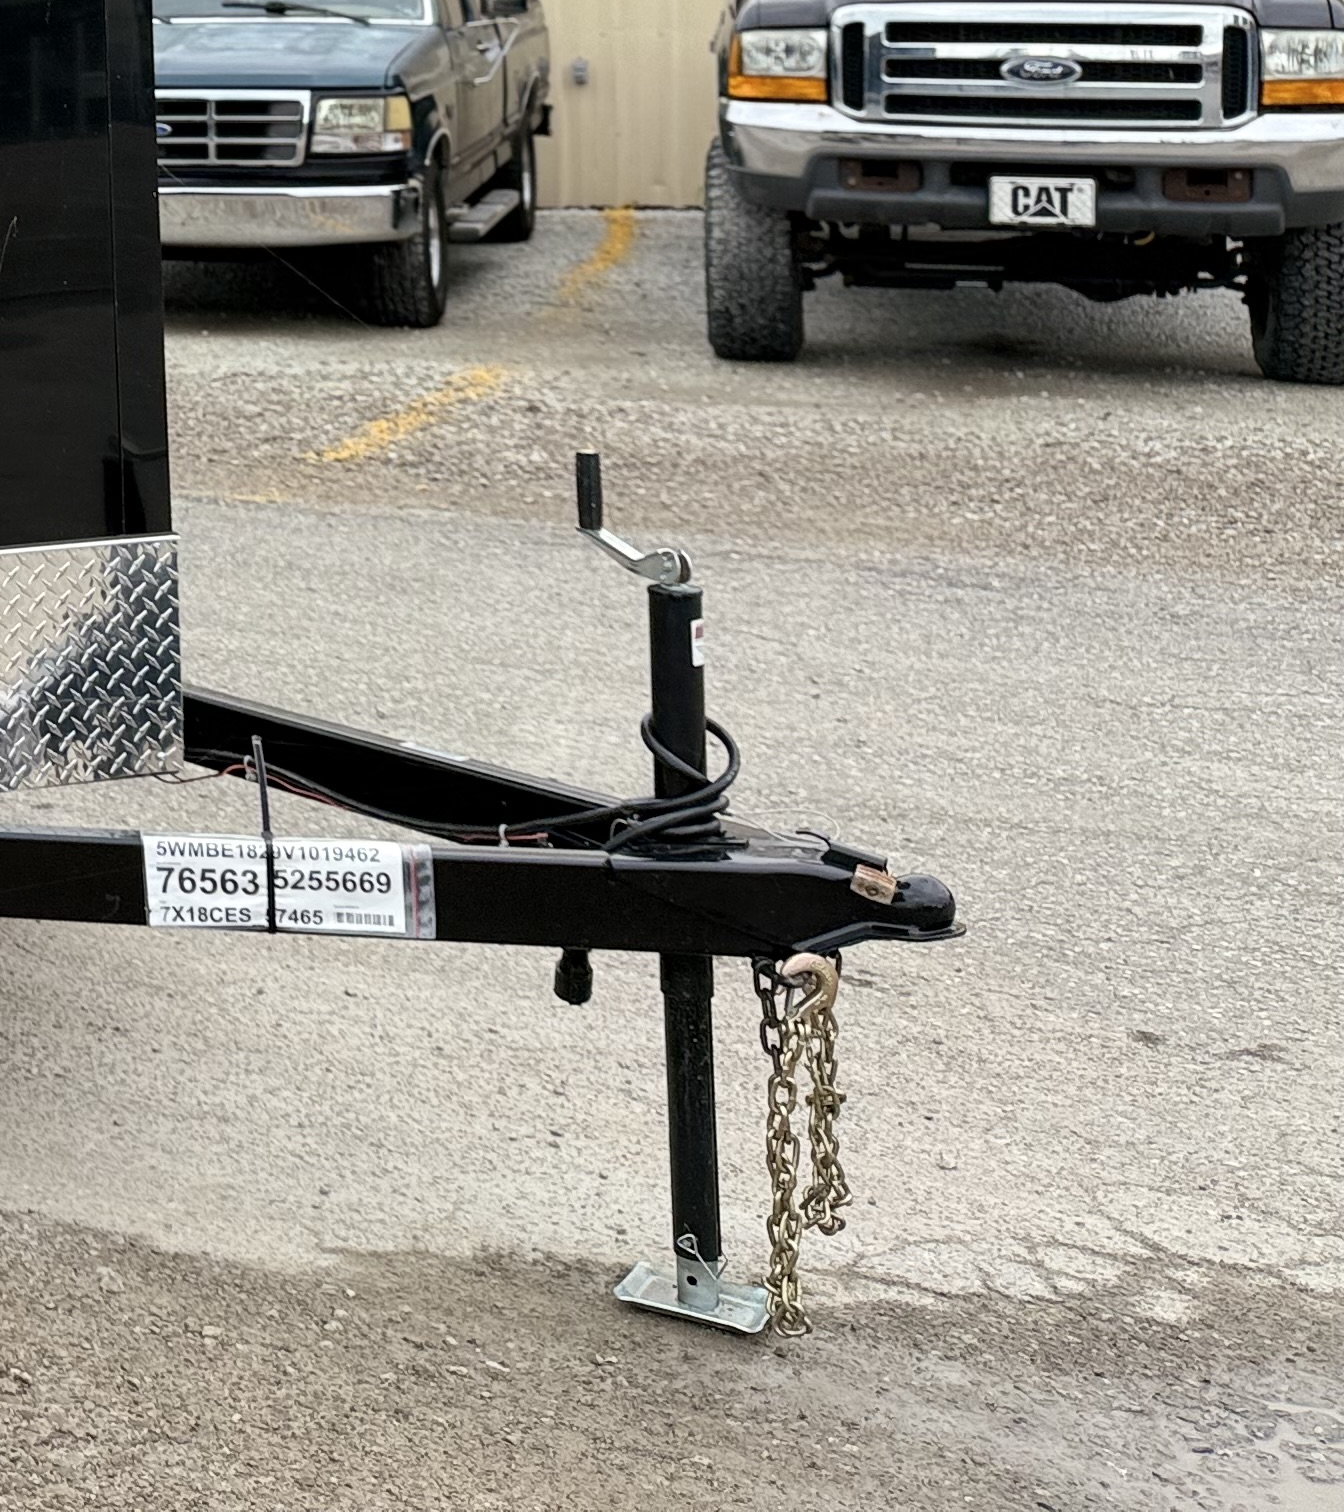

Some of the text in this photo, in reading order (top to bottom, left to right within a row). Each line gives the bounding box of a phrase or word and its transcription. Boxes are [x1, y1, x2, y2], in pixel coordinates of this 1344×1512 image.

[1011, 185, 1073, 217] CAT
[156, 867, 392, 895] 76563 5255669
[160, 905, 324, 925] 7X18CES 7465
